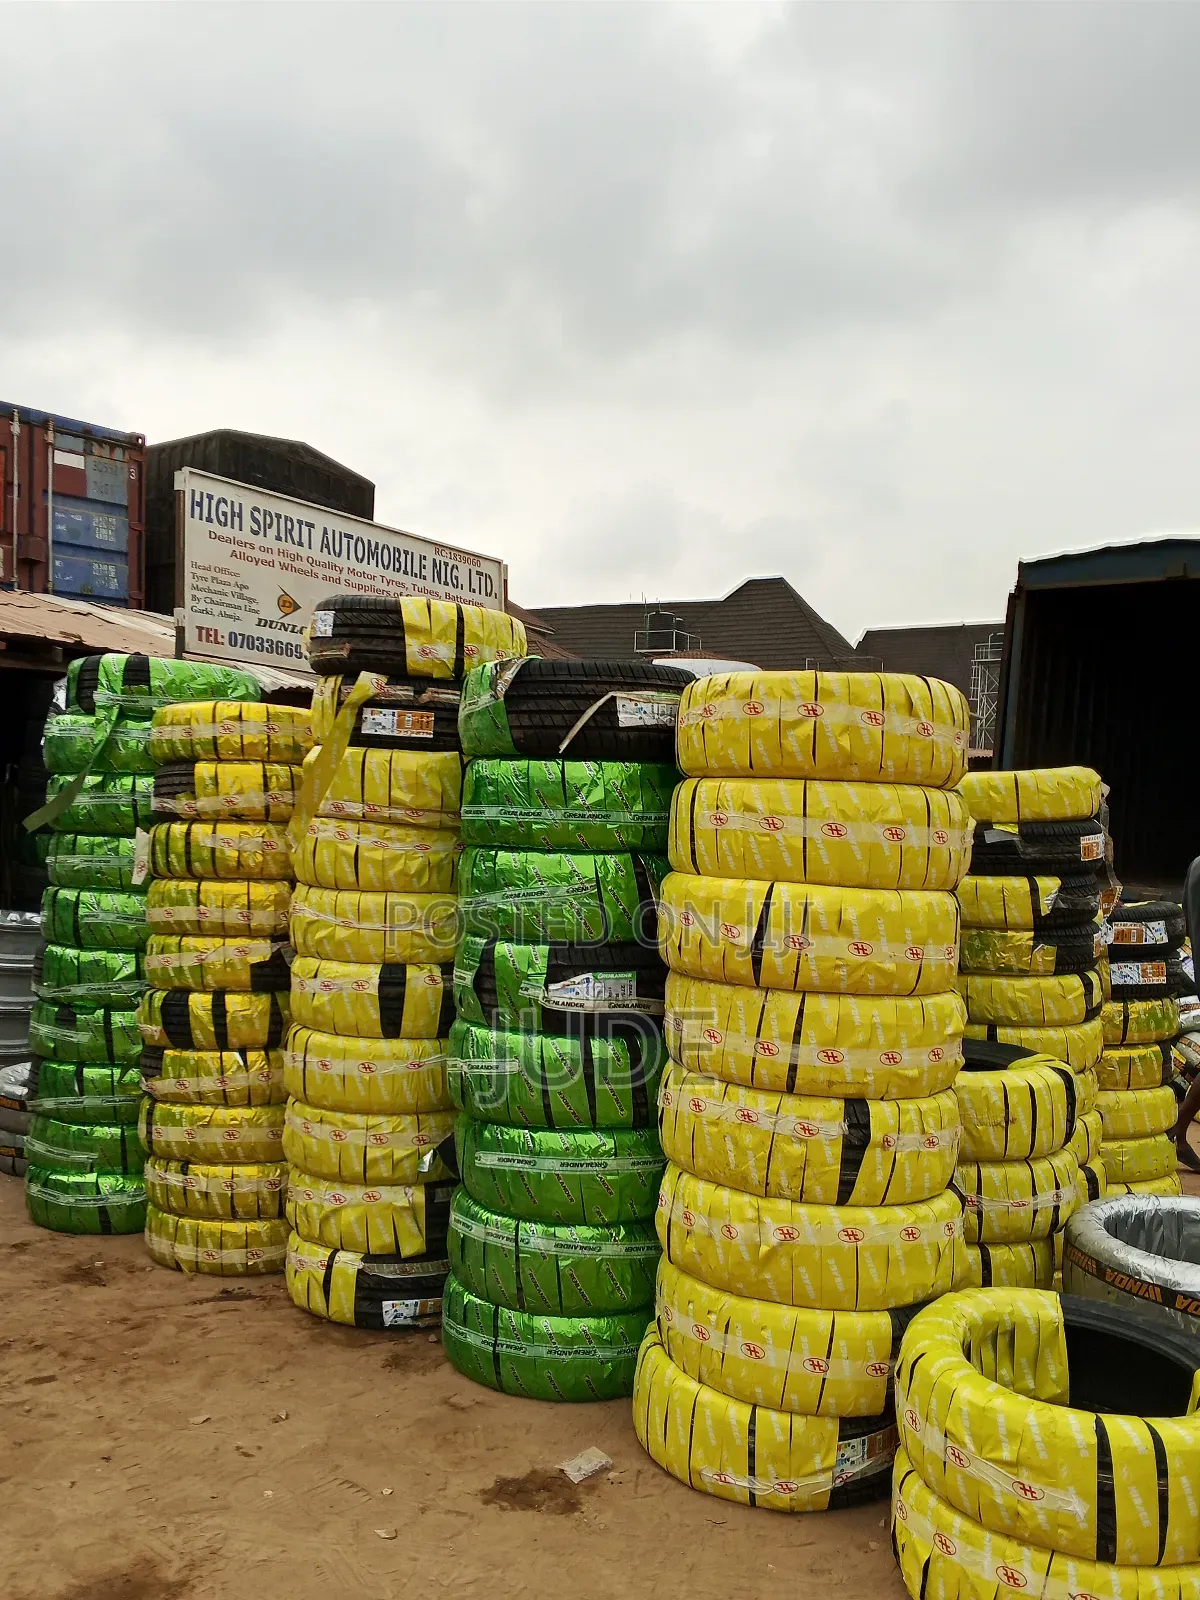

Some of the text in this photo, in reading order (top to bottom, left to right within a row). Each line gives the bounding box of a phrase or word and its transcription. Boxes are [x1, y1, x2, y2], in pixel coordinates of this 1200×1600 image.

[190, 489, 498, 600] HIGH SPIRIT AUTOMOBILE NIG. LTD.
[208, 530, 256, 550] Dealers
[258, 544, 274, 555] on
[277, 548, 303, 563] High
[306, 555, 344, 575] Quality
[347, 566, 378, 582] Motor
[379, 574, 409, 590] Tyres,
[411, 583, 442, 599] Tubes,
[434, 547, 481, 568] RC:1839060
[190, 561, 212, 572] Head
[230, 549, 275, 568] Alloyed
[278, 560, 319, 579] Wheels
[321, 572, 341, 585] and
[344, 579, 394, 597] Suppliers
[190, 572, 249, 591] Tyre Plaza Apo
[191, 583, 229, 597] Mechanic
[191, 594, 260, 615] By Chairman Line
[191, 605, 216, 617] Garki,
[195, 625, 309, 660] TEL: 07033669
[500, 808, 543, 818] GRENLANDER
[563, 810, 612, 821] GRENLANDER
[598, 972, 633, 980] GRENLANDER
[607, 1002, 652, 1011] GRENLANDER
[559, 1160, 608, 1170] GRENLANDER
[553, 1242, 602, 1254] GRENLANDER
[1105, 1268, 1163, 1303] WINDA
